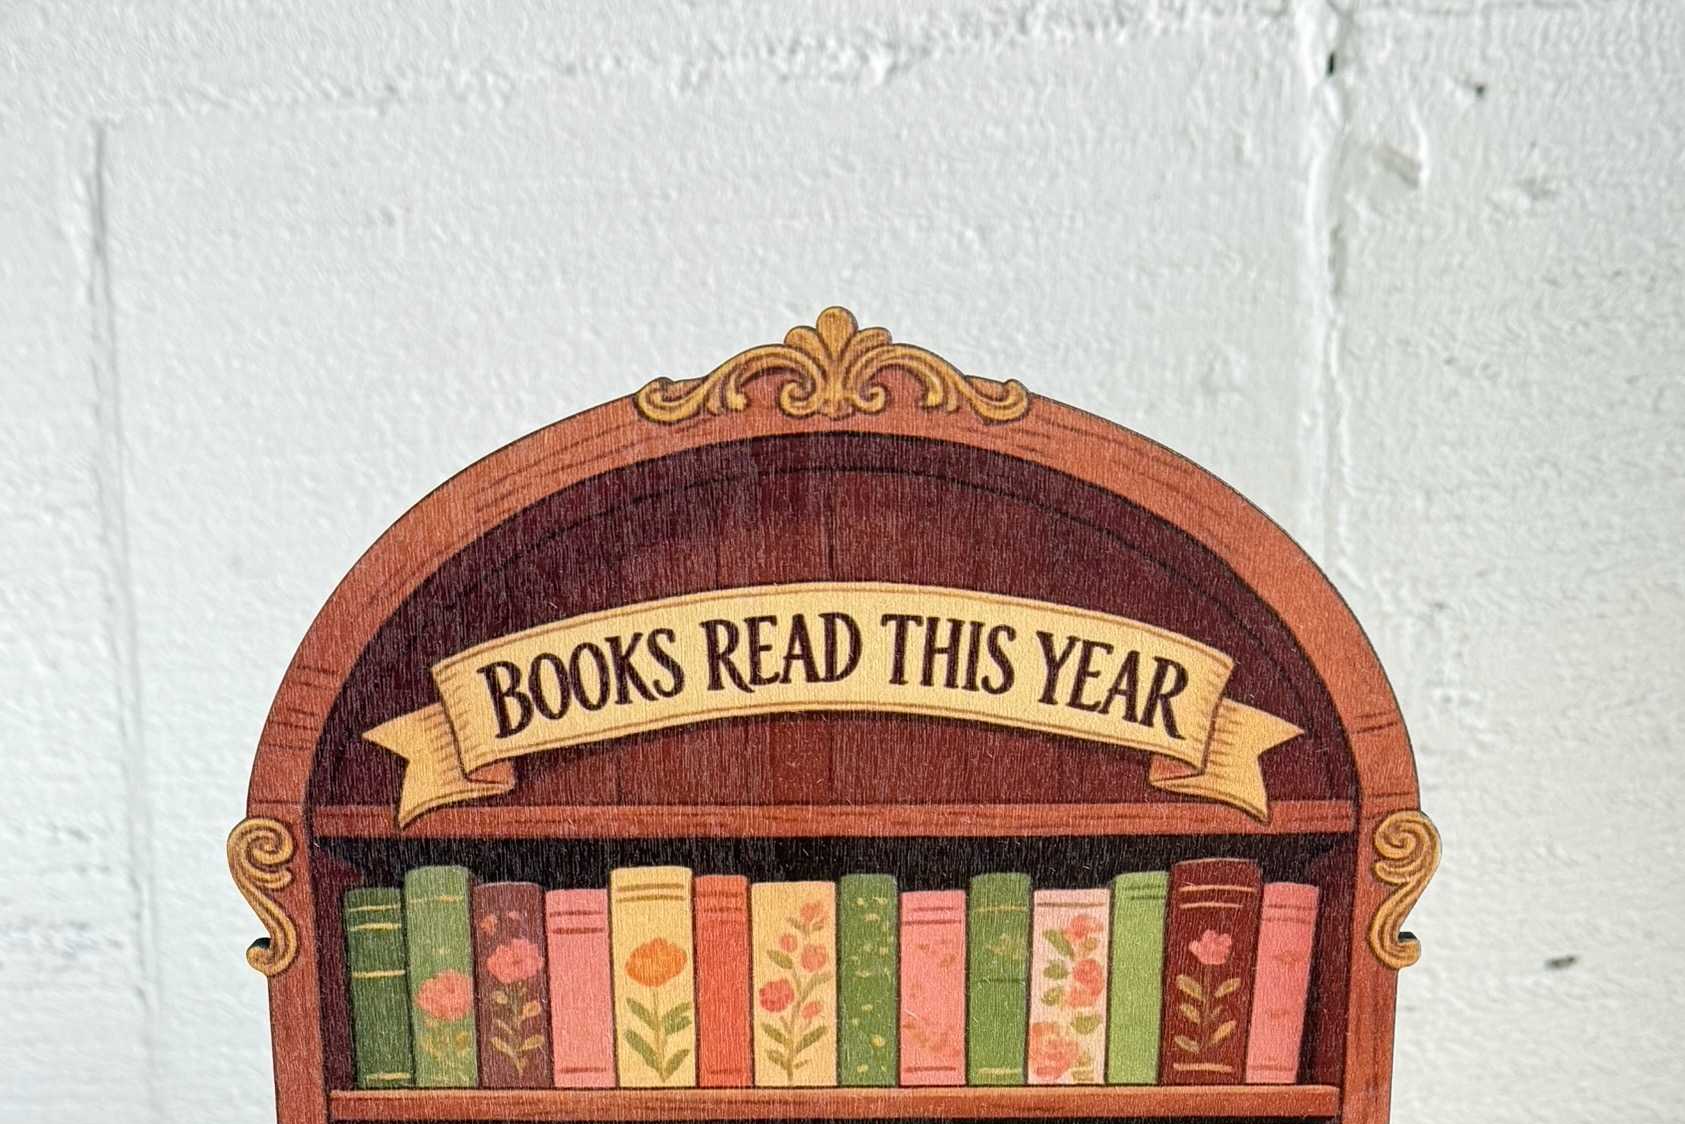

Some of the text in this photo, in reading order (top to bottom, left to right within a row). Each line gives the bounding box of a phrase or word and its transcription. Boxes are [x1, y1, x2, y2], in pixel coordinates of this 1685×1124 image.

[477, 611, 1191, 741] BOOKS READ THIS YEAR
